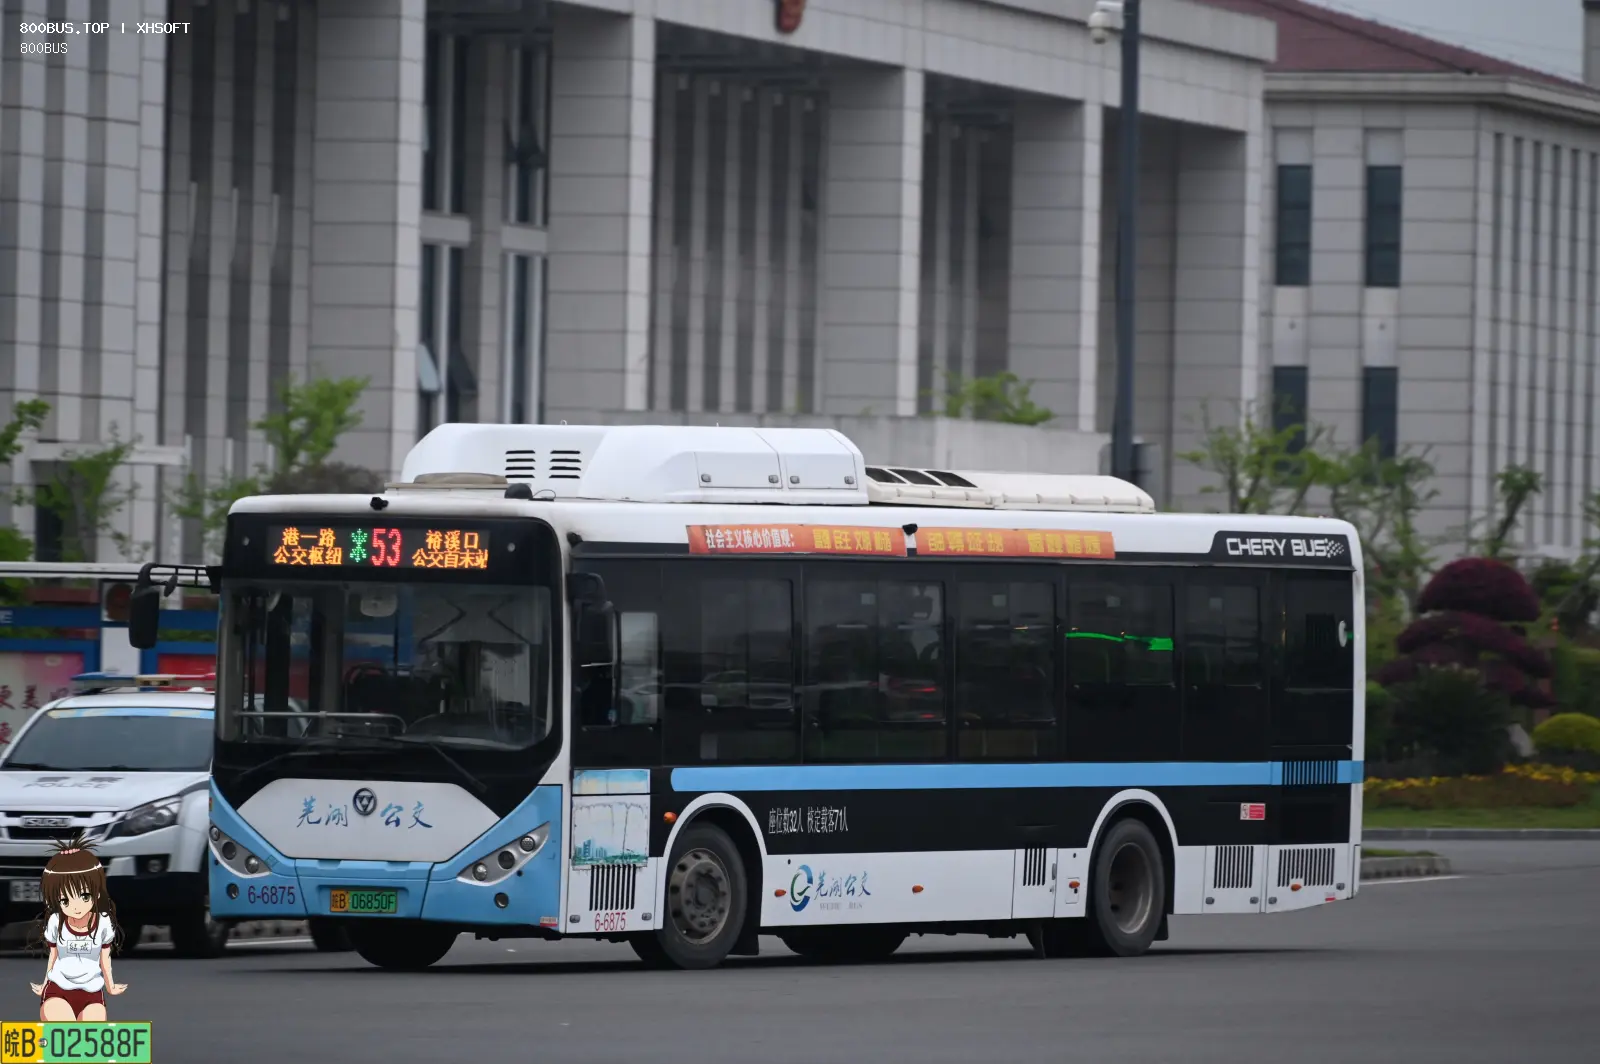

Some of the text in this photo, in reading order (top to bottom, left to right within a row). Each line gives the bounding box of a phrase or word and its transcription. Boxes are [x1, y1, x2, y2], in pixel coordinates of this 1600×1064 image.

[282, 527, 336, 547] 港一路
[426, 530, 479, 550] 裕溪口
[273, 546, 342, 565] 公交枢纽
[371, 528, 401, 567] 53
[1226, 538, 1327, 557] CHERY BUS
[412, 549, 488, 569] 公交首末站
[380, 801, 433, 829] 公交
[247, 885, 296, 905] 6-6875
[351, 893, 396, 910] 06850F
[594, 912, 627, 931] 6-6875
